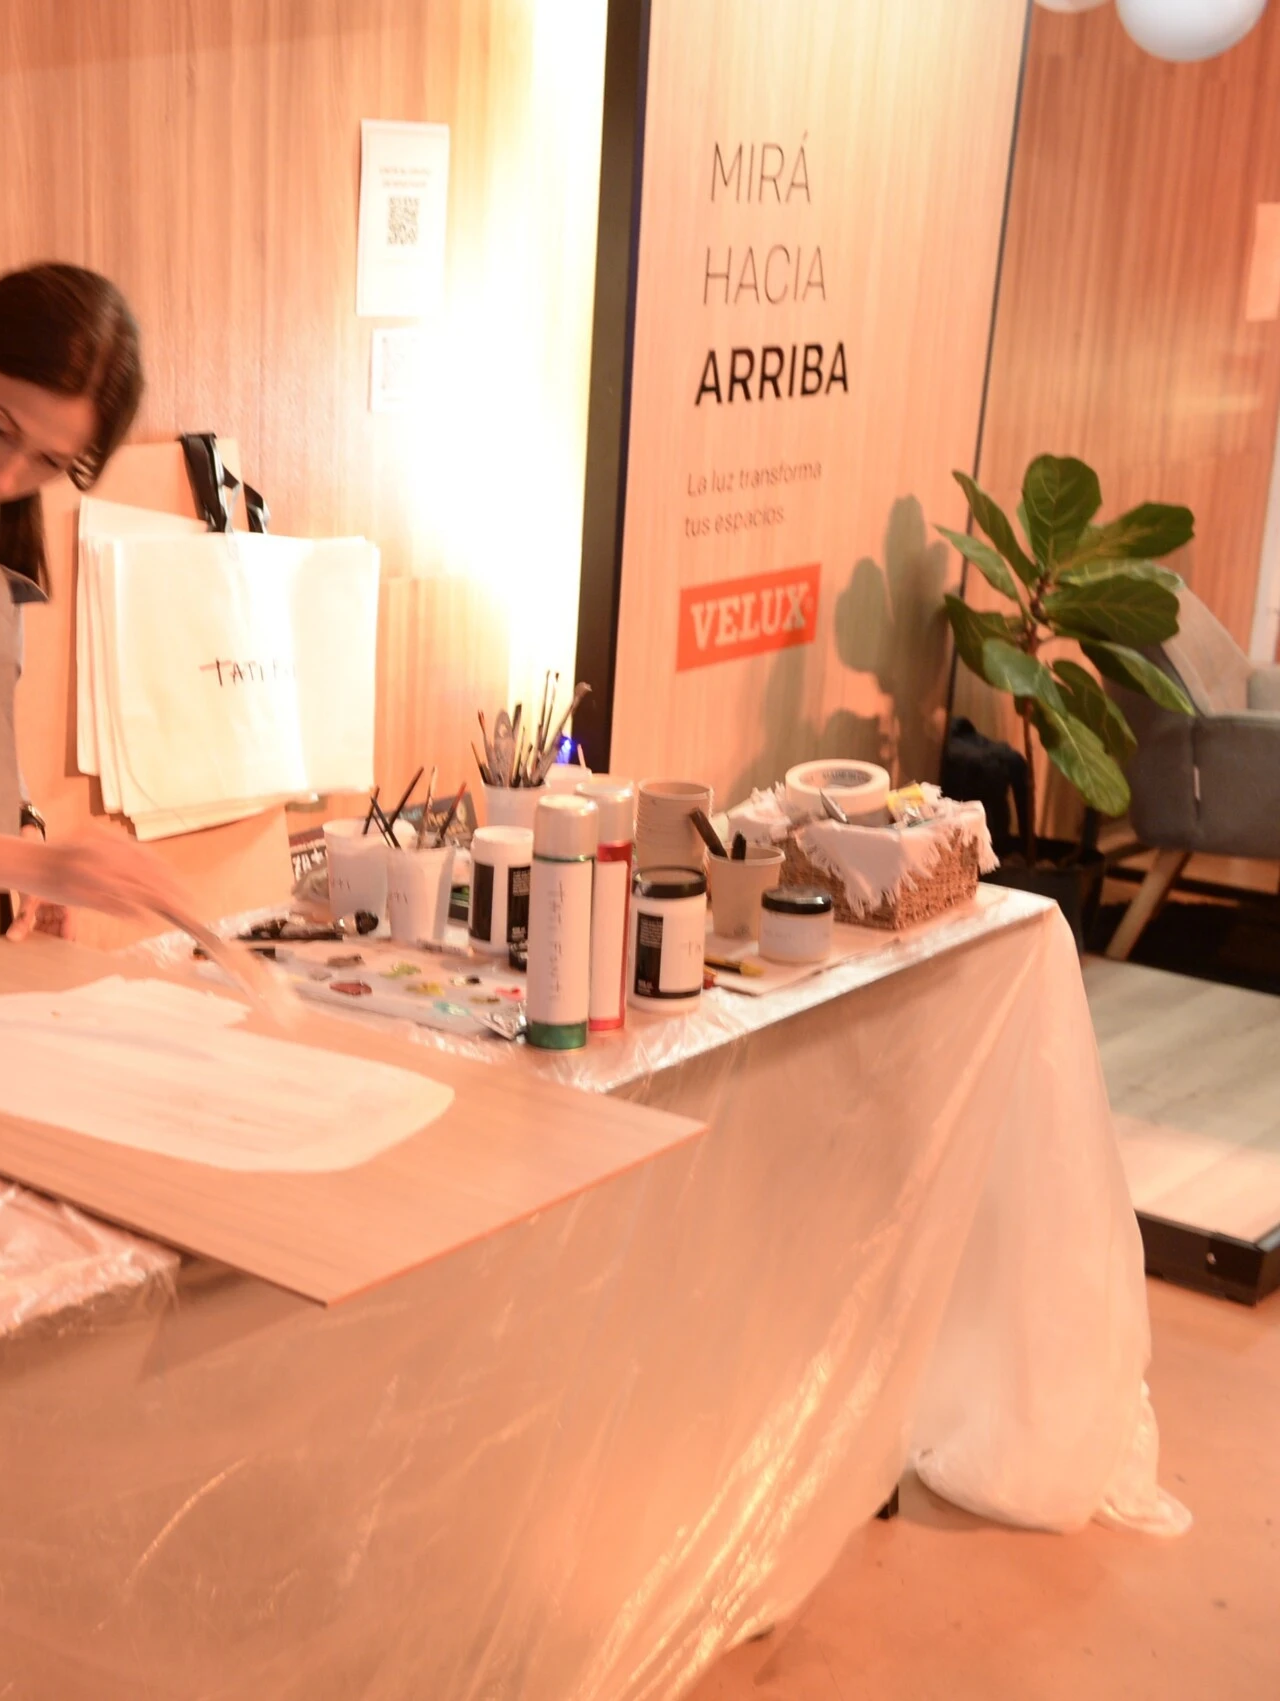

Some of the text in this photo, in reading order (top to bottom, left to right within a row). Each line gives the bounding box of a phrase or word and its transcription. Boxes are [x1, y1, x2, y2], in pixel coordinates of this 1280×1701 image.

[710, 129, 811, 203] MIRÁ
[702, 244, 826, 305] HACIA
[694, 340, 849, 407] ARRIBA
[686, 460, 822, 497] La luz transforma
[684, 505, 785, 538] tus espacios
[690, 581, 810, 651] VELUX
